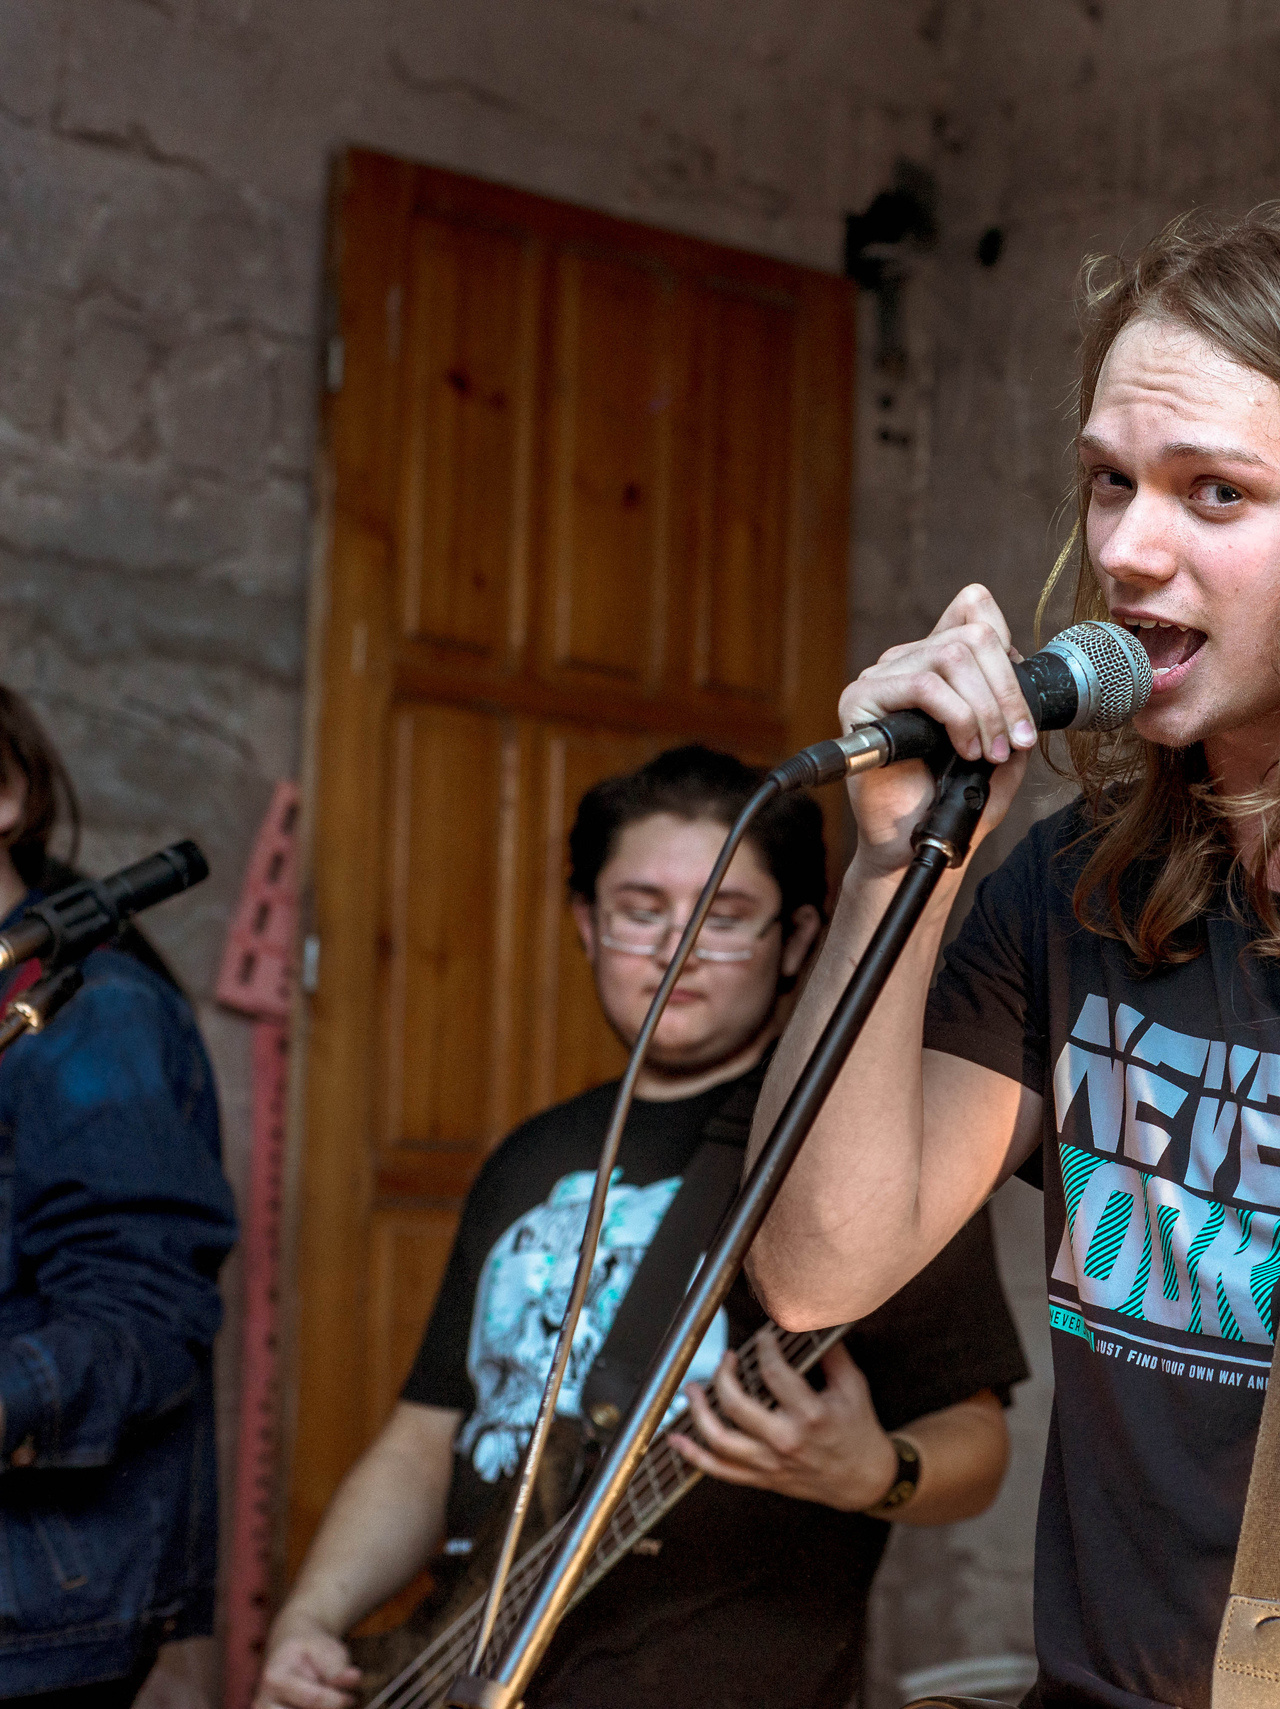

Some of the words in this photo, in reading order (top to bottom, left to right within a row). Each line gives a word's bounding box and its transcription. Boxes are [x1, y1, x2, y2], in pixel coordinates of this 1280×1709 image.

[1095, 1339, 1123, 1359] JUST
[1126, 1349, 1158, 1370] FIND
[1160, 1358, 1185, 1376] YOUR
[1188, 1364, 1214, 1382] OWN
[1218, 1369, 1244, 1387] WAY
